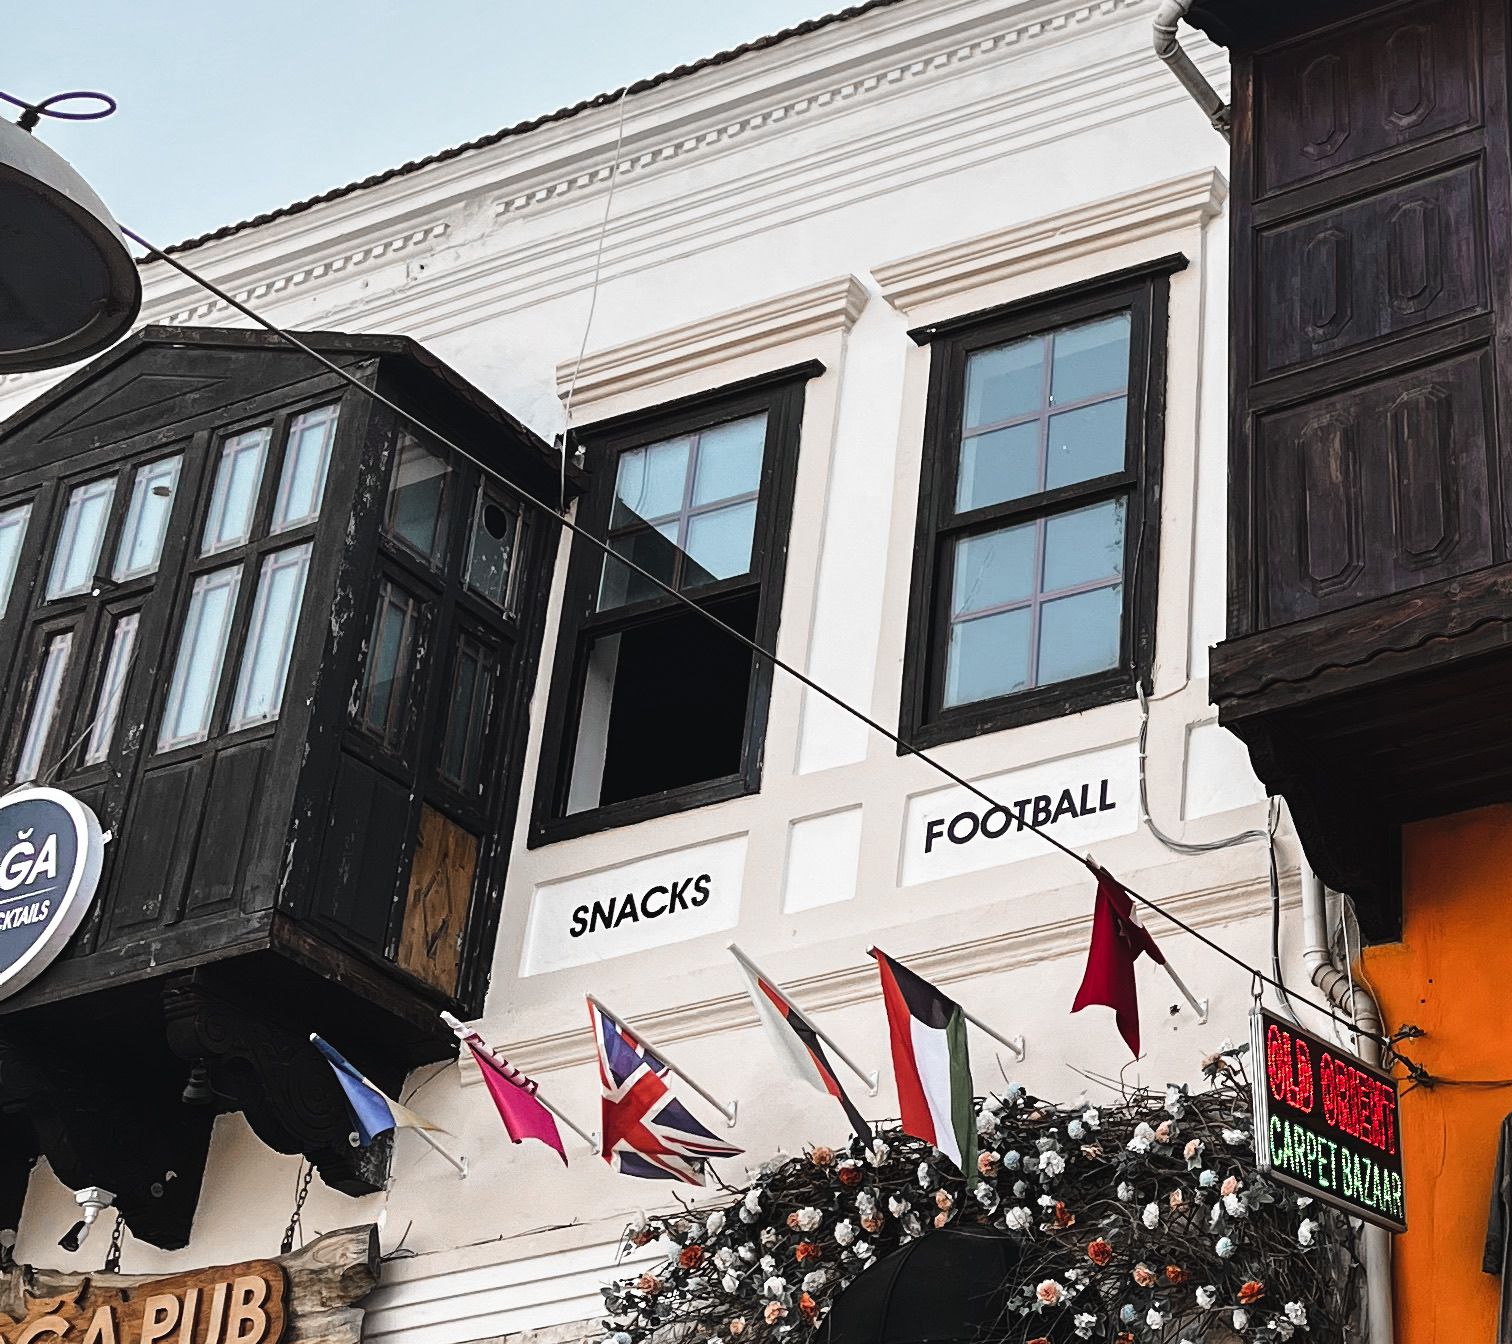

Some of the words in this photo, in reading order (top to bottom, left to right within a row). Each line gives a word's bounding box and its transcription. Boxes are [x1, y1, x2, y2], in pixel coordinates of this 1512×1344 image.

[923, 778, 1117, 853] FOOTBALL
[568, 873, 712, 938] SNACKS
[1320, 1052, 1396, 1156] ORIENT
[1269, 1115, 1338, 1190] CARPET
[1341, 1145, 1404, 1220] BAZAAR
